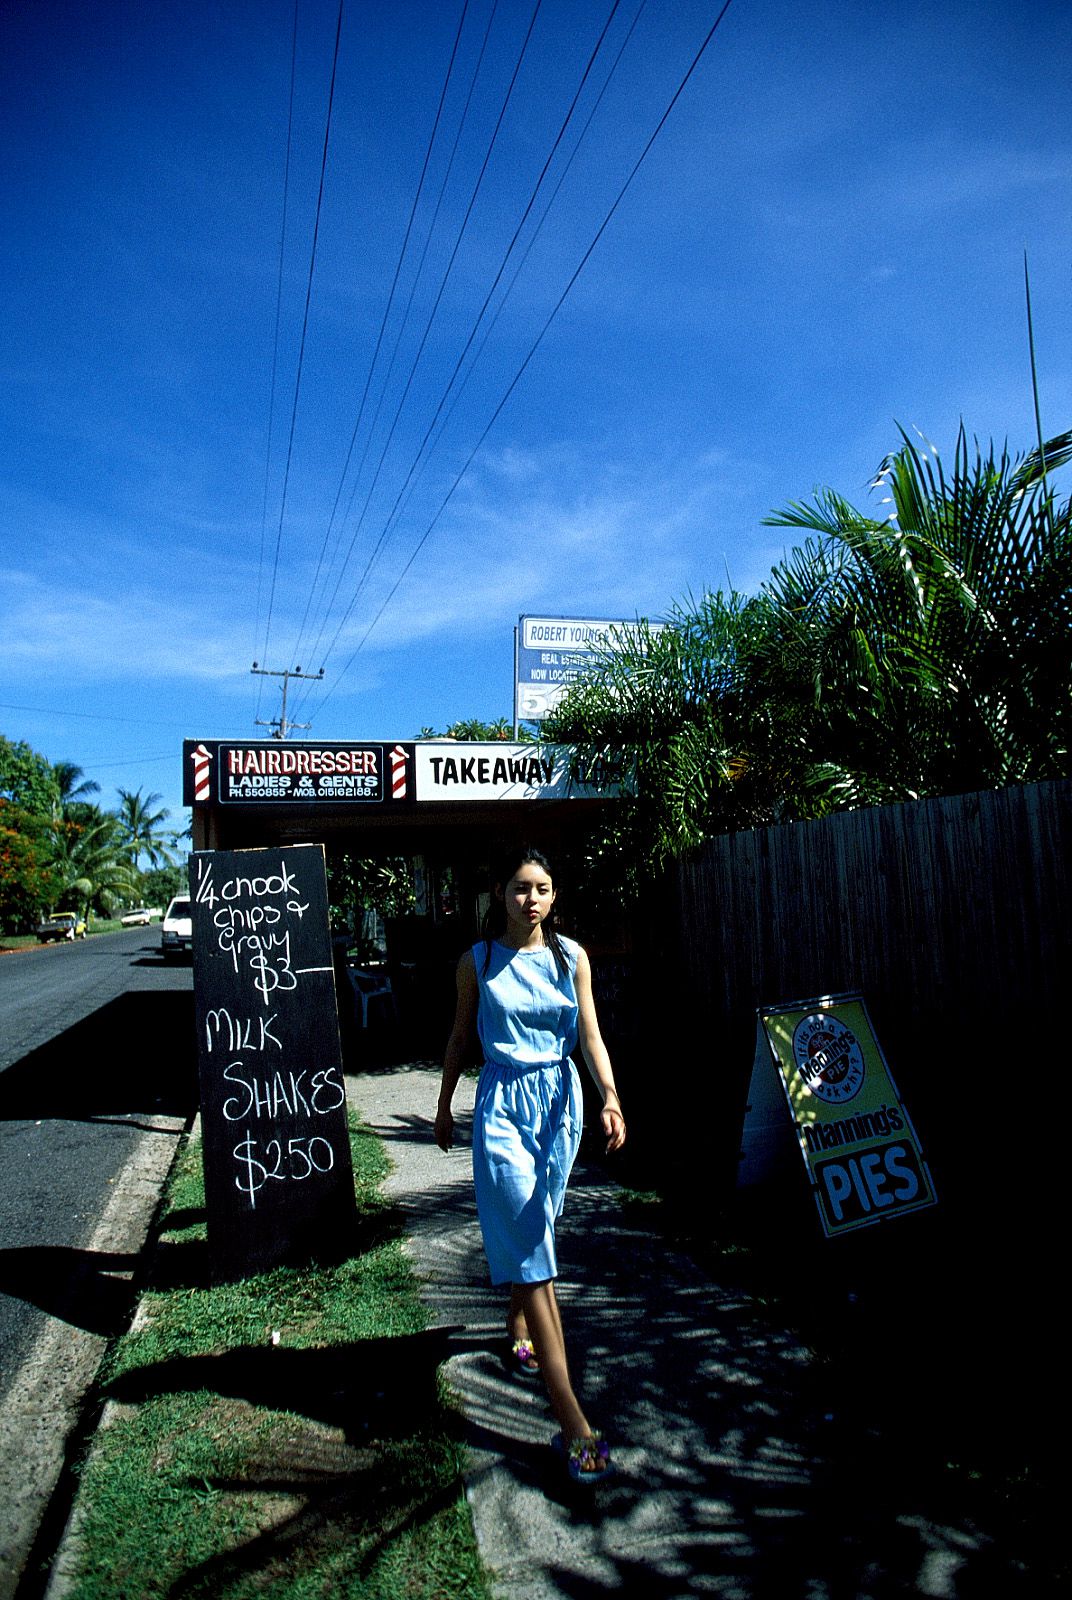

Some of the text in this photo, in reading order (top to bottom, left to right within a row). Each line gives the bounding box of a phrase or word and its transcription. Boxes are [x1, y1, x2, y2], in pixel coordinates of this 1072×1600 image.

[530, 626, 568, 642] ROBERT
[570, 627, 601, 643] YOUNG
[541, 653, 558, 664] REAL
[531, 669, 547, 680] NOW
[549, 669, 578, 682] LOCATED
[228, 750, 378, 774] HAIRDRESSER
[429, 757, 553, 786] TAKEAWAY
[229, 776, 378, 788] LADIES & GENTS
[213, 904, 281, 931] chips
[206, 1008, 283, 1052] MILK
[808, 1020, 825, 1034] not
[818, 1057, 862, 1097] ask why?
[826, 1059, 847, 1080] PIE
[223, 1061, 345, 1121] SHAKES
[803, 1104, 905, 1153] Manning's
[822, 1146, 919, 1221] PIES
